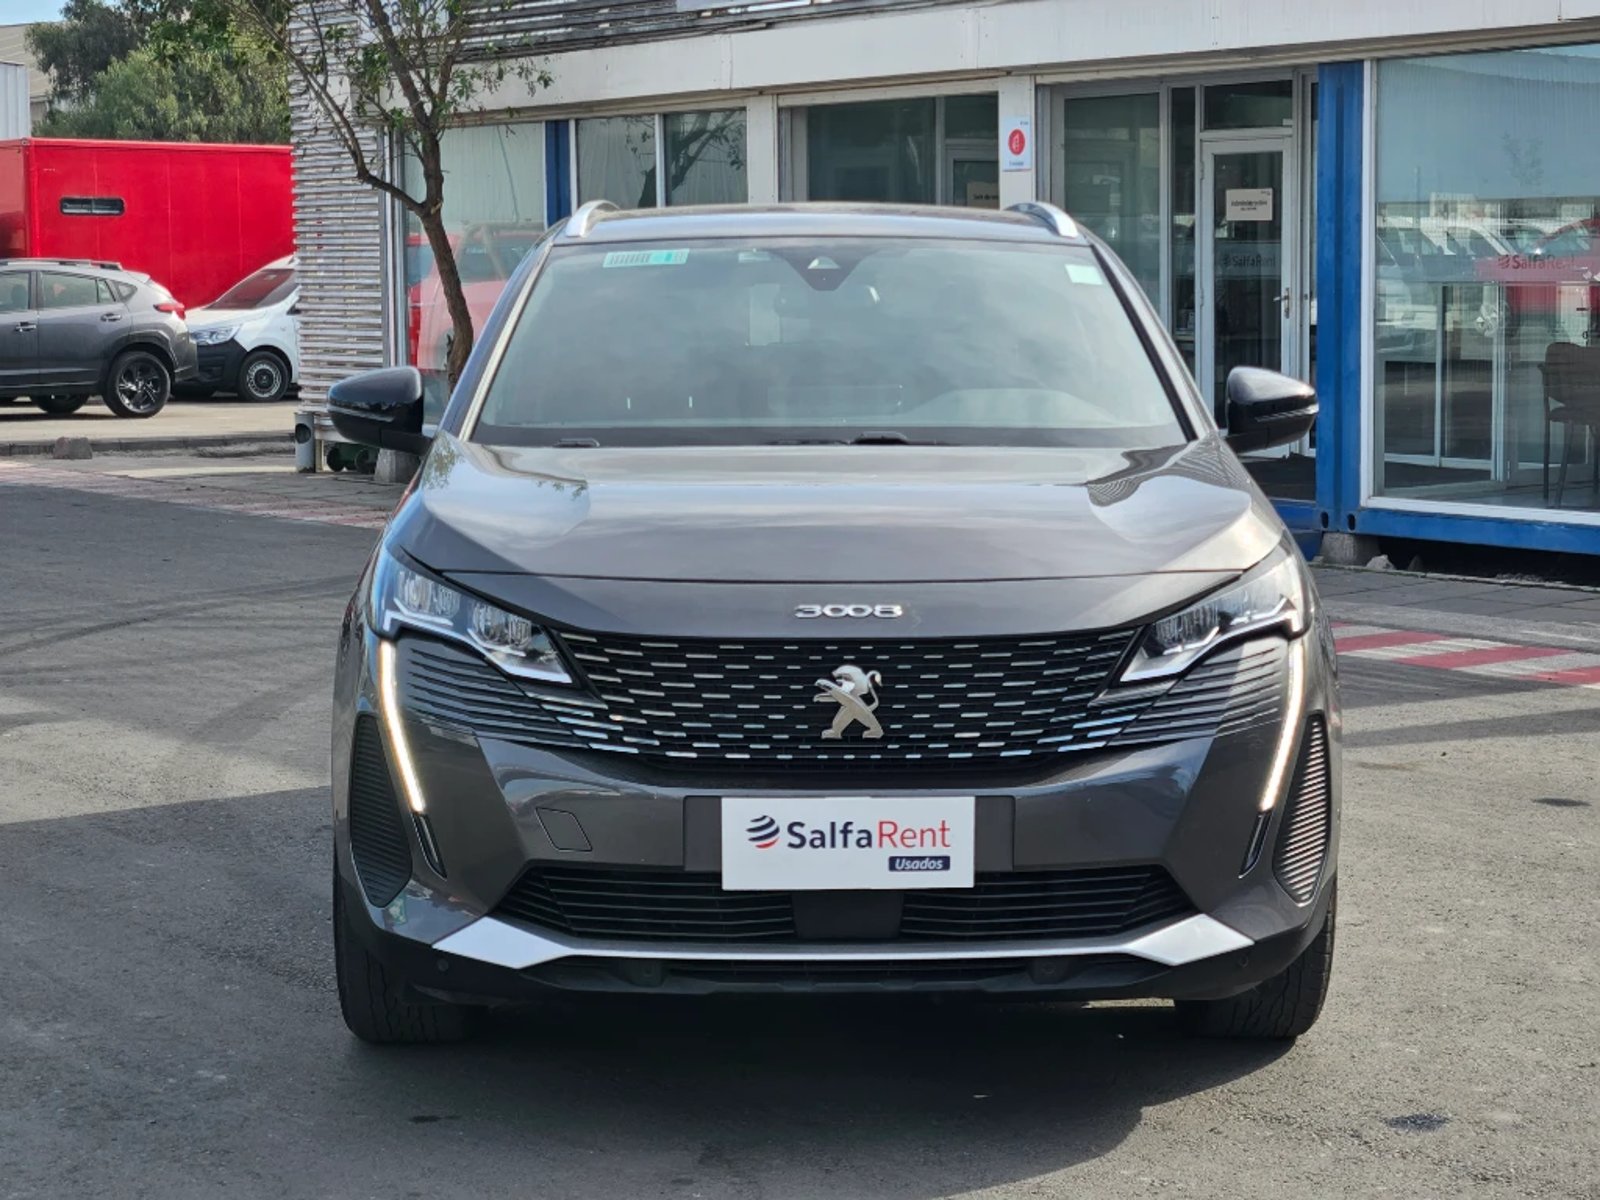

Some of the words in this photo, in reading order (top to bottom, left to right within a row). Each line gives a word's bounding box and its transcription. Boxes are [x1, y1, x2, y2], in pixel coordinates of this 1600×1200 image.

[1231, 254, 1276, 268] SalfaRnt
[794, 604, 903, 619] 3008
[786, 820, 951, 850] SalfaRent
[894, 856, 943, 870] Usados
